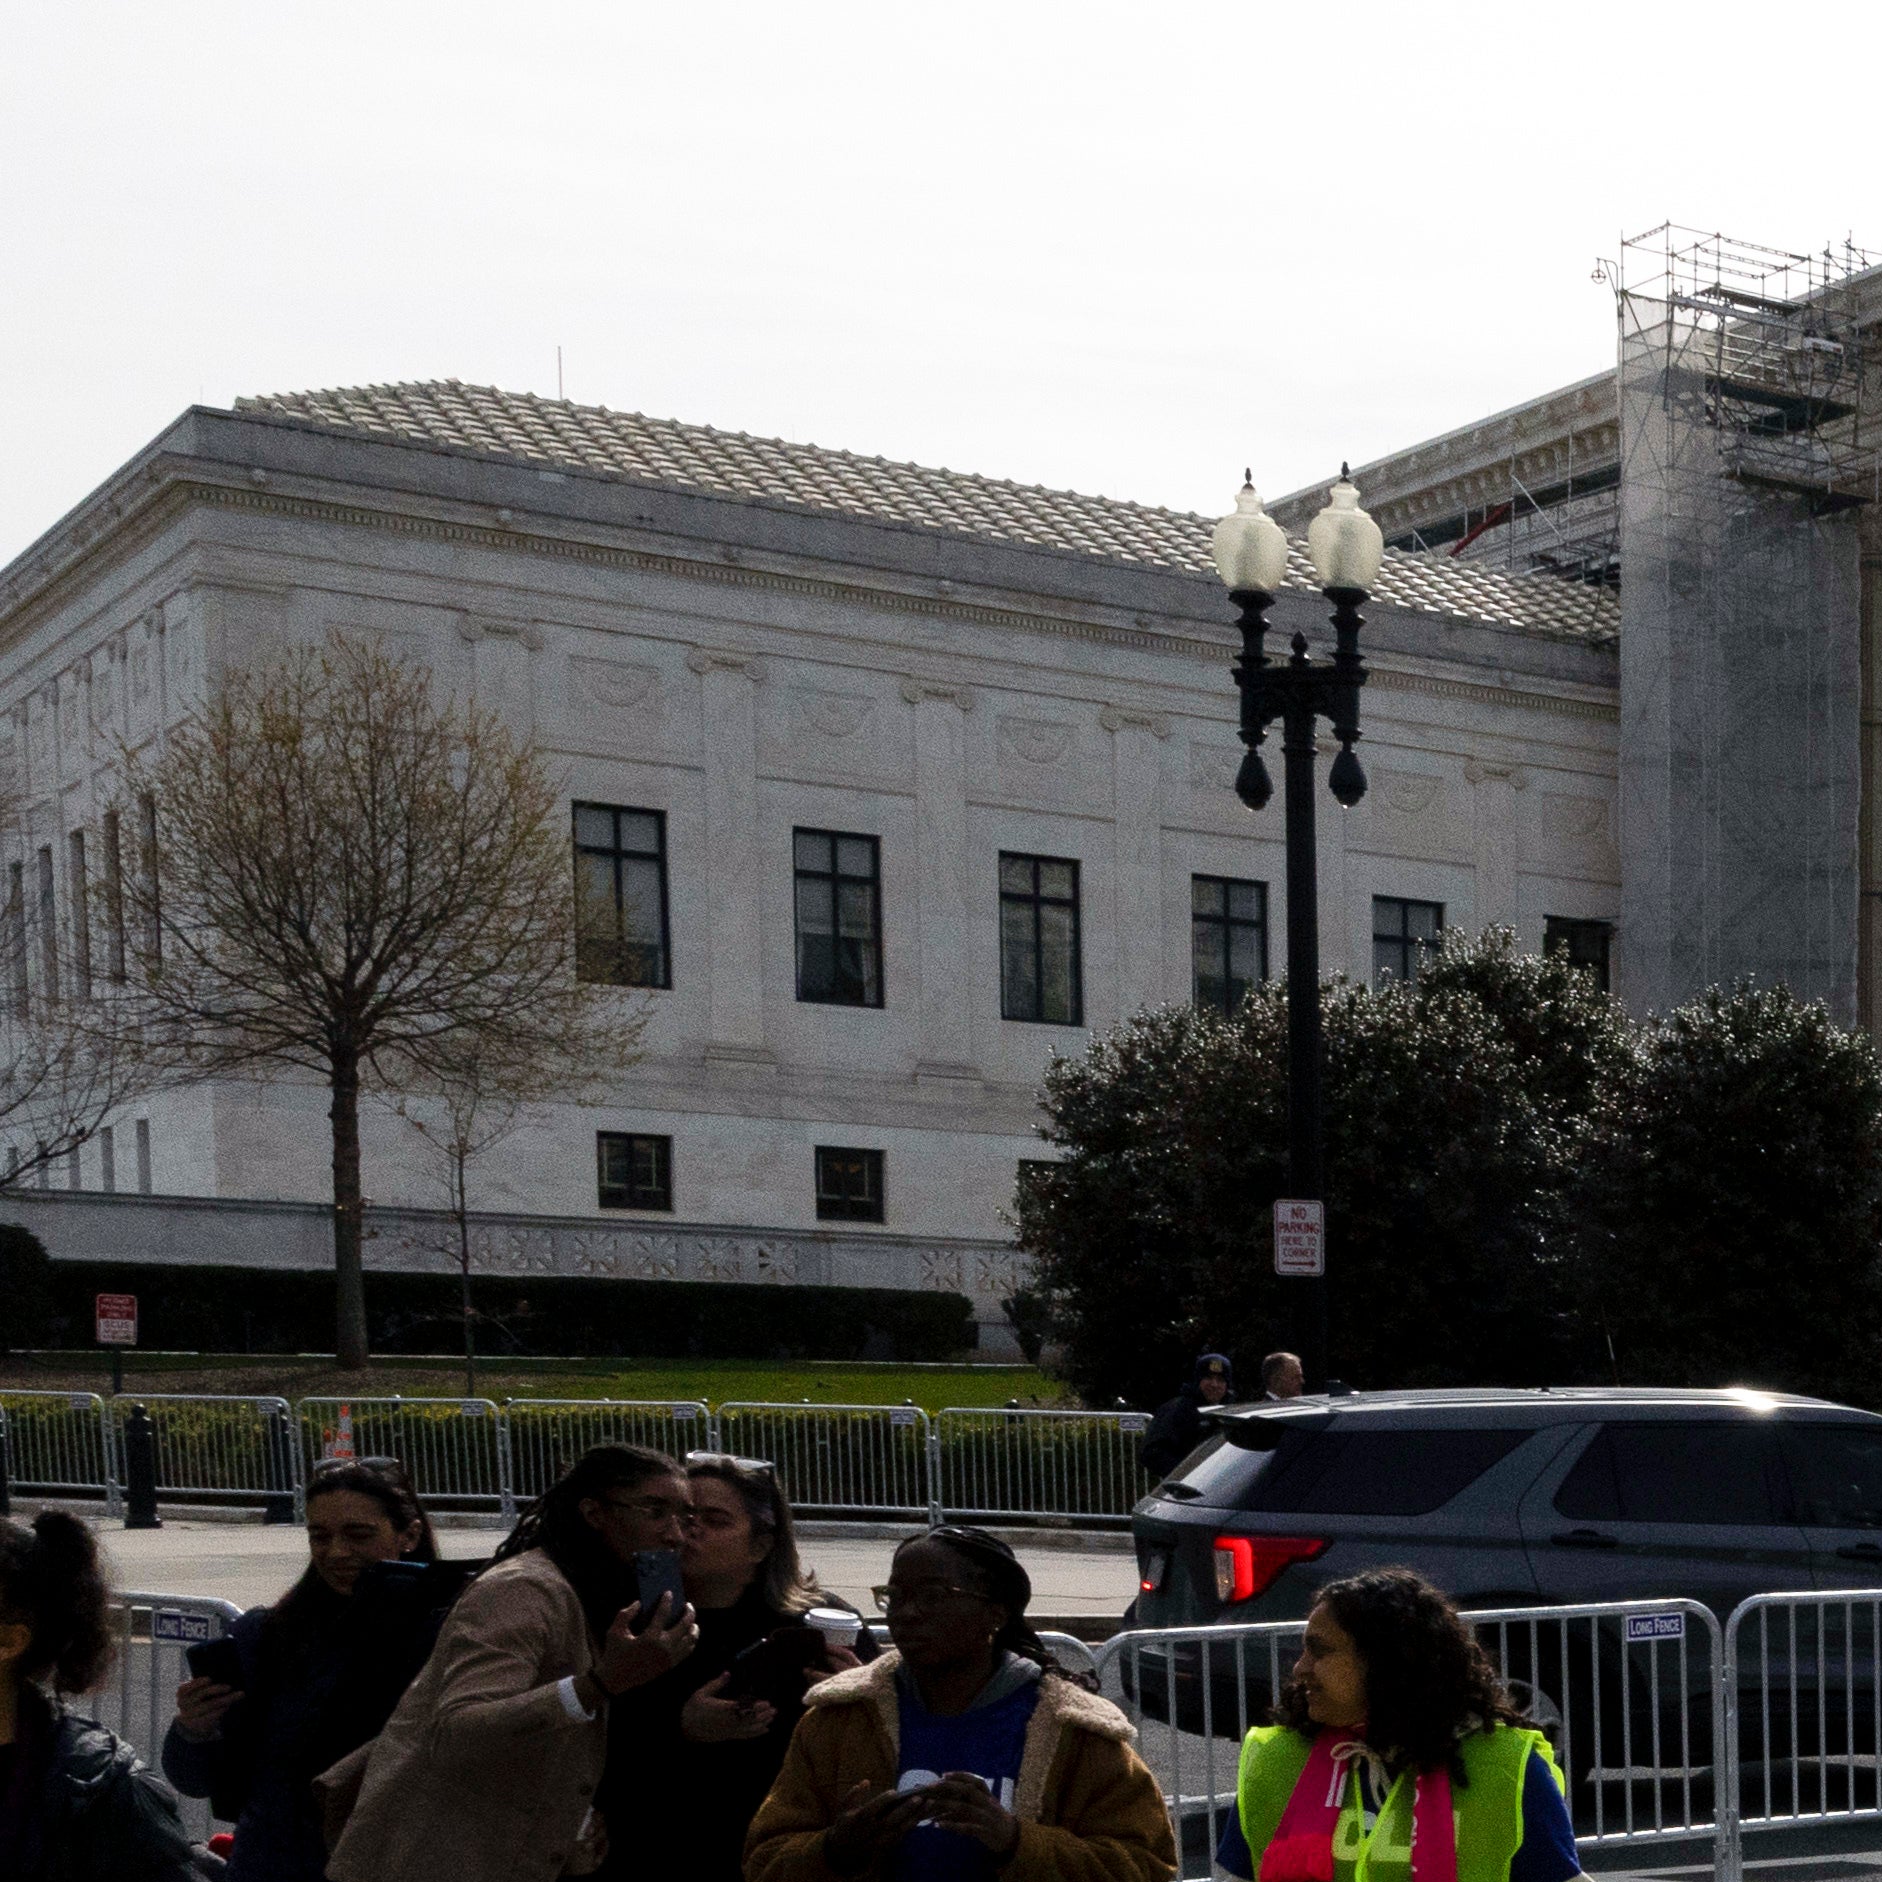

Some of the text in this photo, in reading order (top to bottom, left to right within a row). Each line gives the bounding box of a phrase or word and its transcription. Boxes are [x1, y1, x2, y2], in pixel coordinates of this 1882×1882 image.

[1291, 1206, 1306, 1220] NO
[1278, 1222, 1321, 1235] PARKING
[1282, 1236, 1317, 1246] HERE TO
[1283, 1248, 1315, 1258] CORNER
[156, 1614, 208, 1640] LONG FENCE
[1630, 1617, 1681, 1636] LONG FENCE
